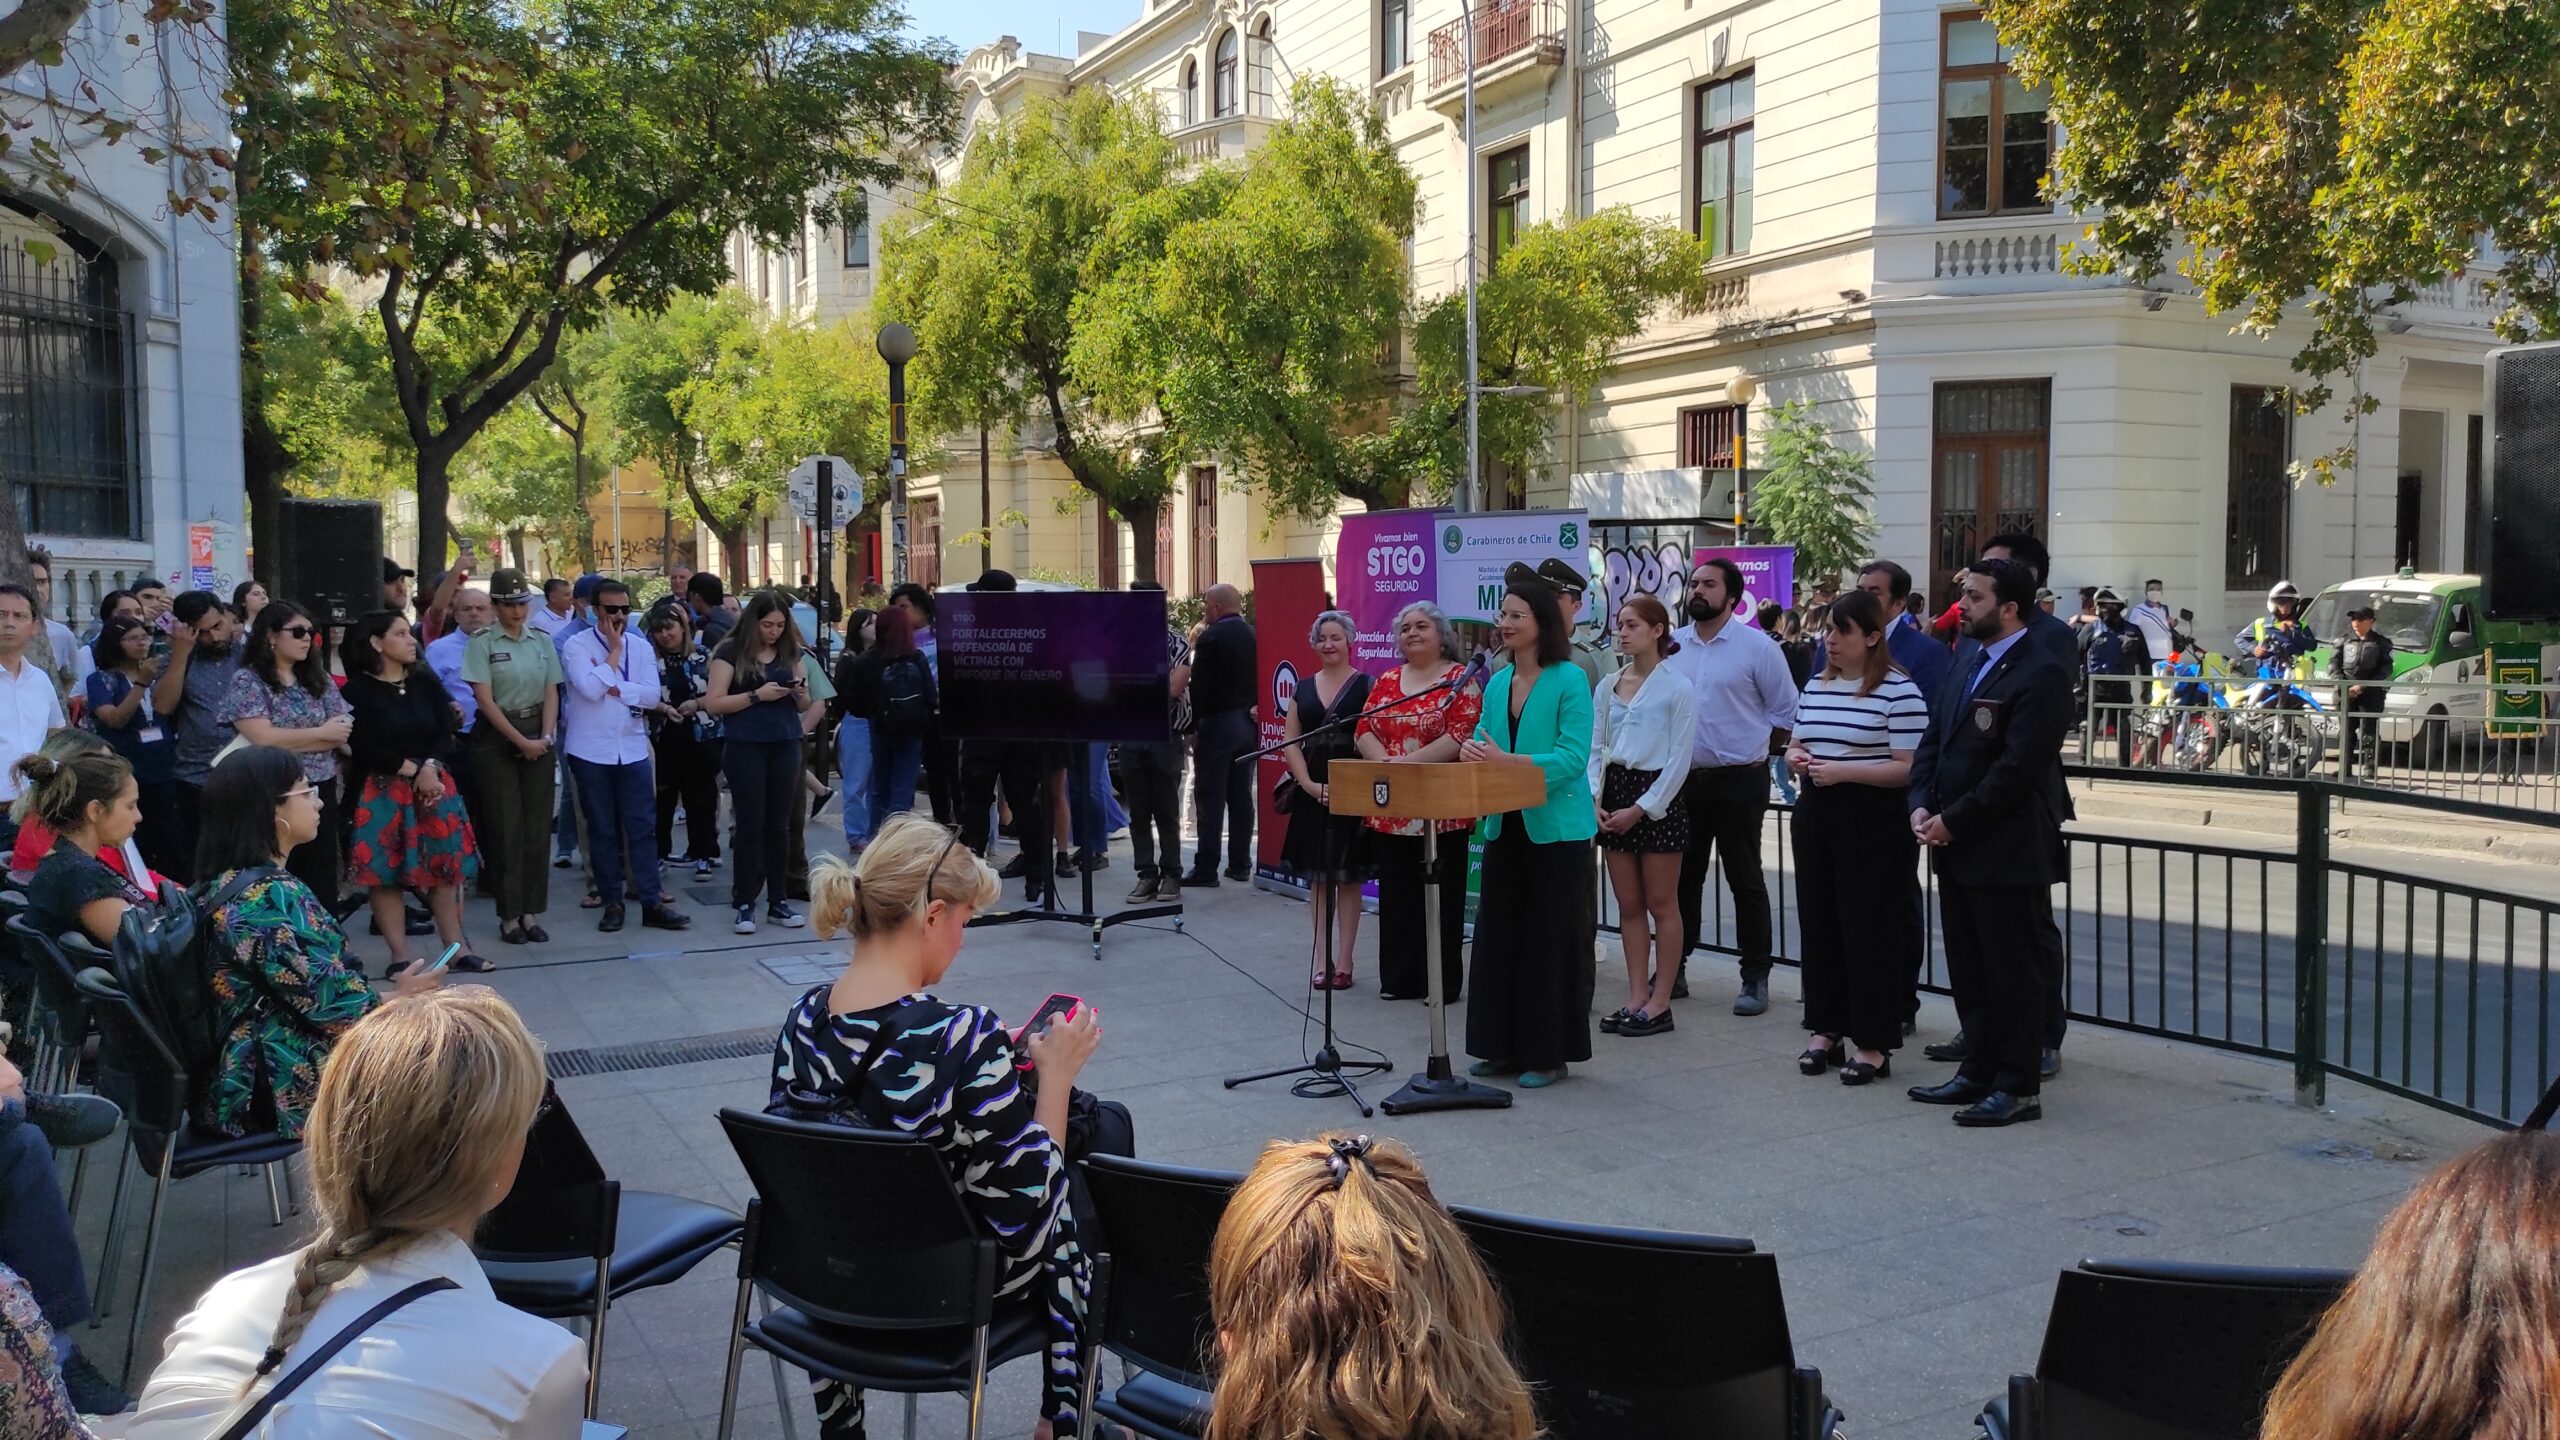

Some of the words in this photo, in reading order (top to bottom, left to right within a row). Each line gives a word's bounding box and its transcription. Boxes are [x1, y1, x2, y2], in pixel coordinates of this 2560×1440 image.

[1374, 533, 1401, 544] Vivamos
[1403, 532, 1419, 542] bien
[1466, 535, 1515, 546] Carabineros
[1517, 534, 1528, 544] de
[1529, 534, 1552, 544] Chile
[1367, 545, 1426, 576] STGO
[1374, 580, 1419, 593] SEGURIDAD
[951, 628, 1046, 640] FORTALECEREMOS
[952, 640, 1016, 653] DEFENSORÍA
[1019, 642, 1033, 653] DE
[1357, 646, 1393, 660] Seguridad
[953, 654, 1000, 666] VÍCTIMAS
[1002, 656, 1024, 666] CON
[954, 669, 1001, 682] ENFOQUE
[1004, 669, 1018, 681] DE
[1020, 667, 1063, 681] GÉNERO
